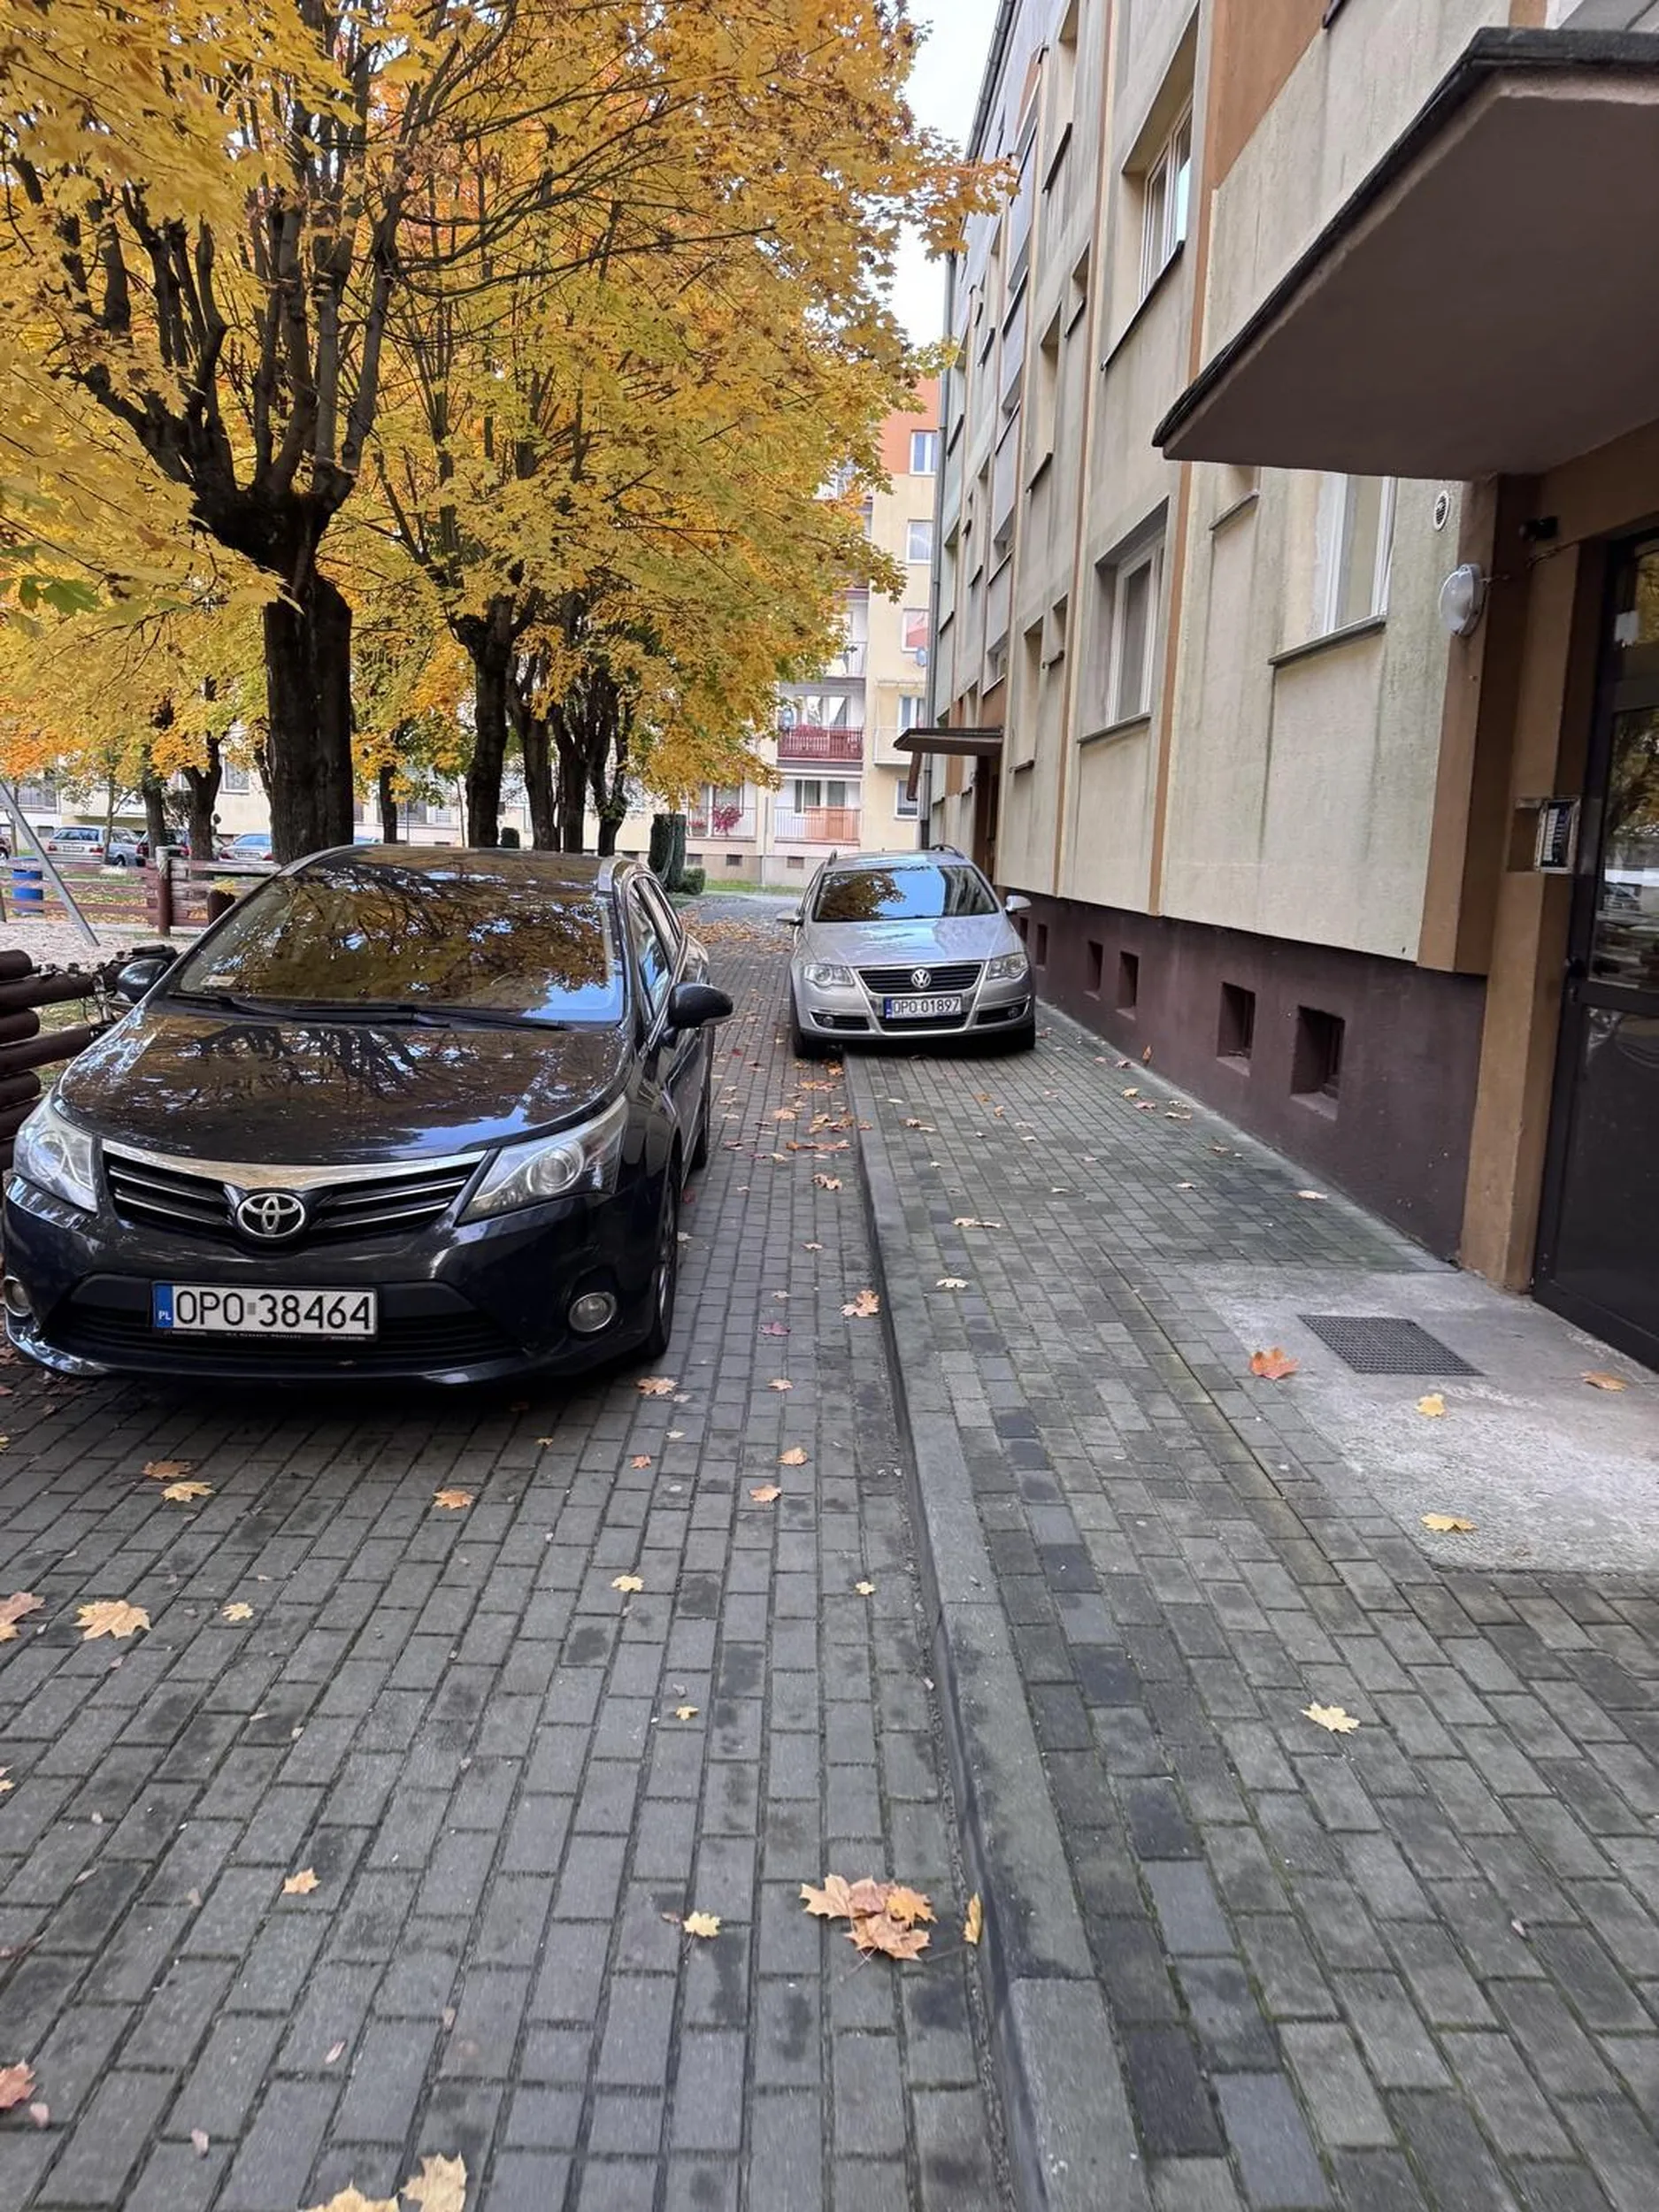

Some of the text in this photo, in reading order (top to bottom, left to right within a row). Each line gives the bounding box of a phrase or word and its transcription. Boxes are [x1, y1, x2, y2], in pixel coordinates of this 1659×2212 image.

[158, 1310, 172, 1320] PL
[176, 1290, 370, 1330] OPO 38464
